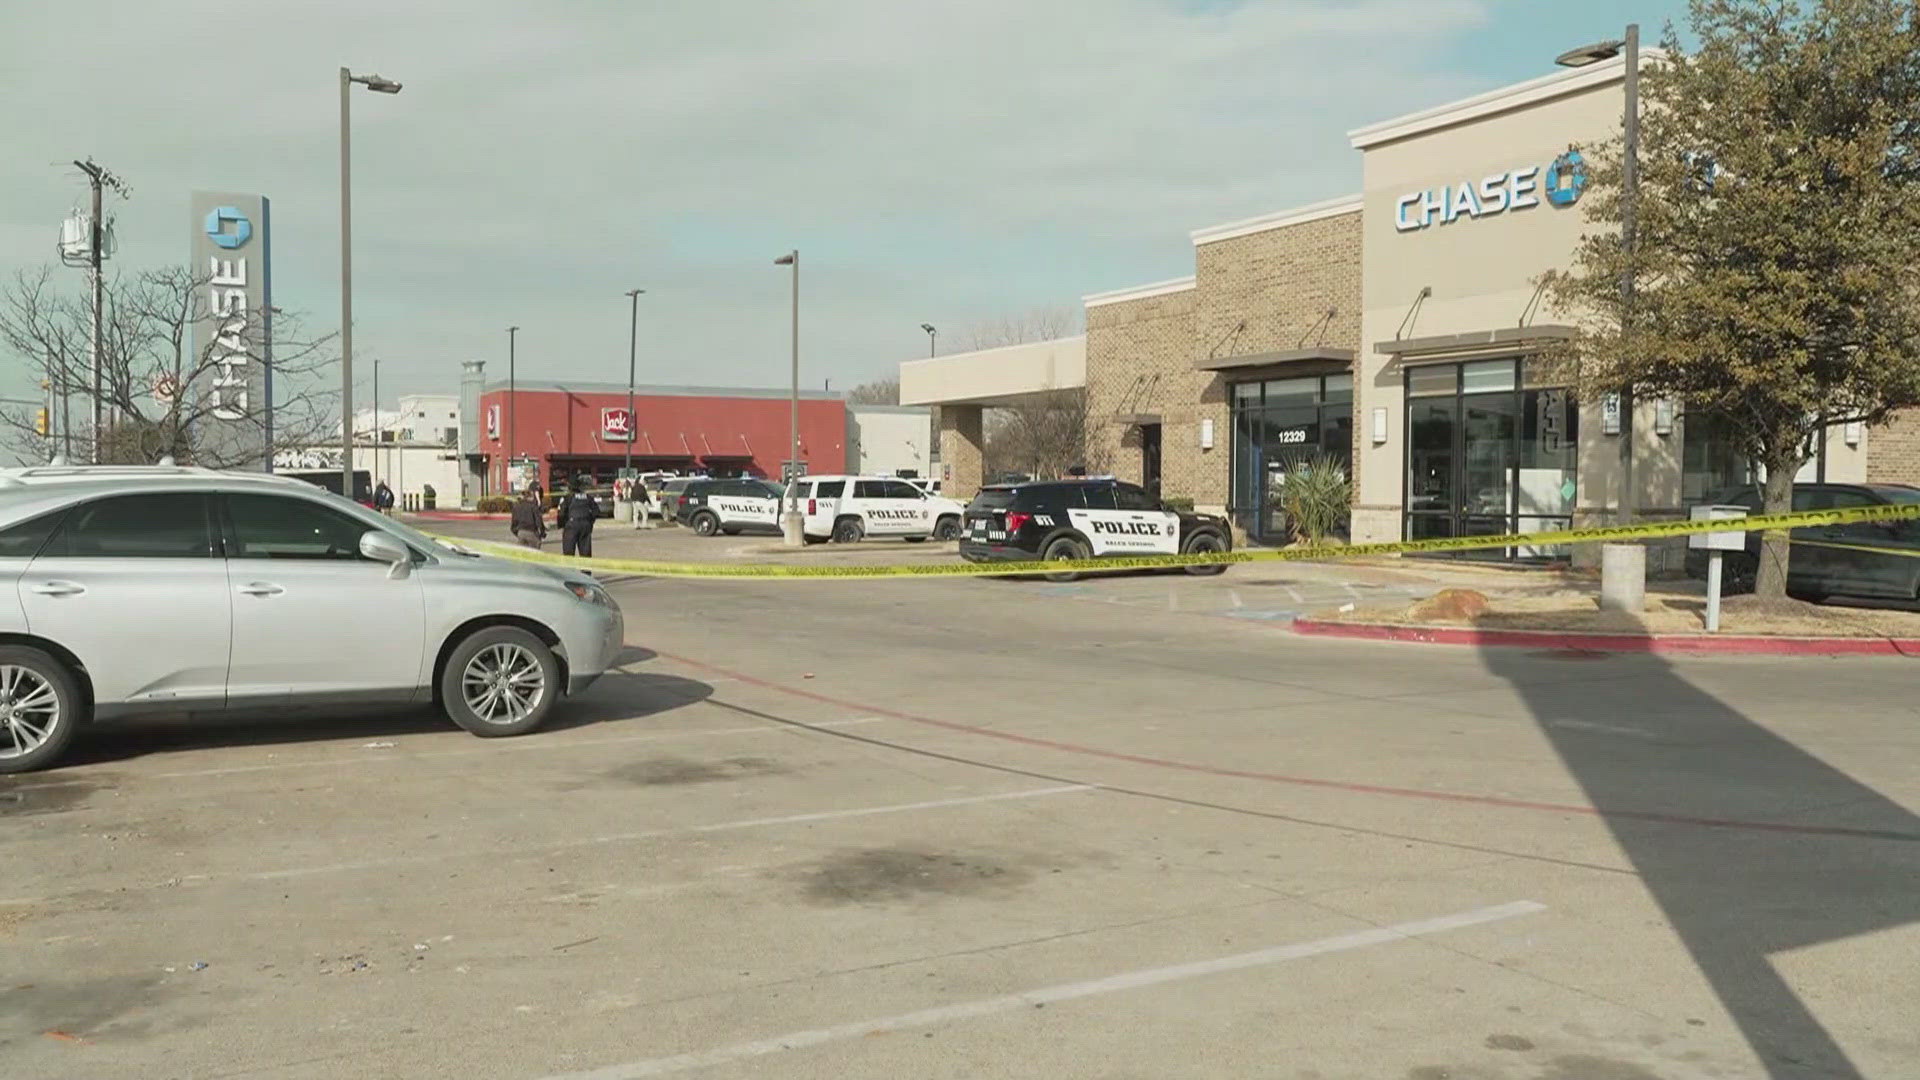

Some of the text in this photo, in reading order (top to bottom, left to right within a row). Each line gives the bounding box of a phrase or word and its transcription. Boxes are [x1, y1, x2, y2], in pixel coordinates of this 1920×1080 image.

[1395, 166, 1539, 232] CHASE
[210, 256, 247, 420] CHASE
[604, 411, 629, 431] Jack
[1278, 430, 1306, 443] 12329
[720, 503, 766, 514] POLICE
[866, 509, 919, 520] POLICE
[1090, 520, 1161, 536] POLICE
